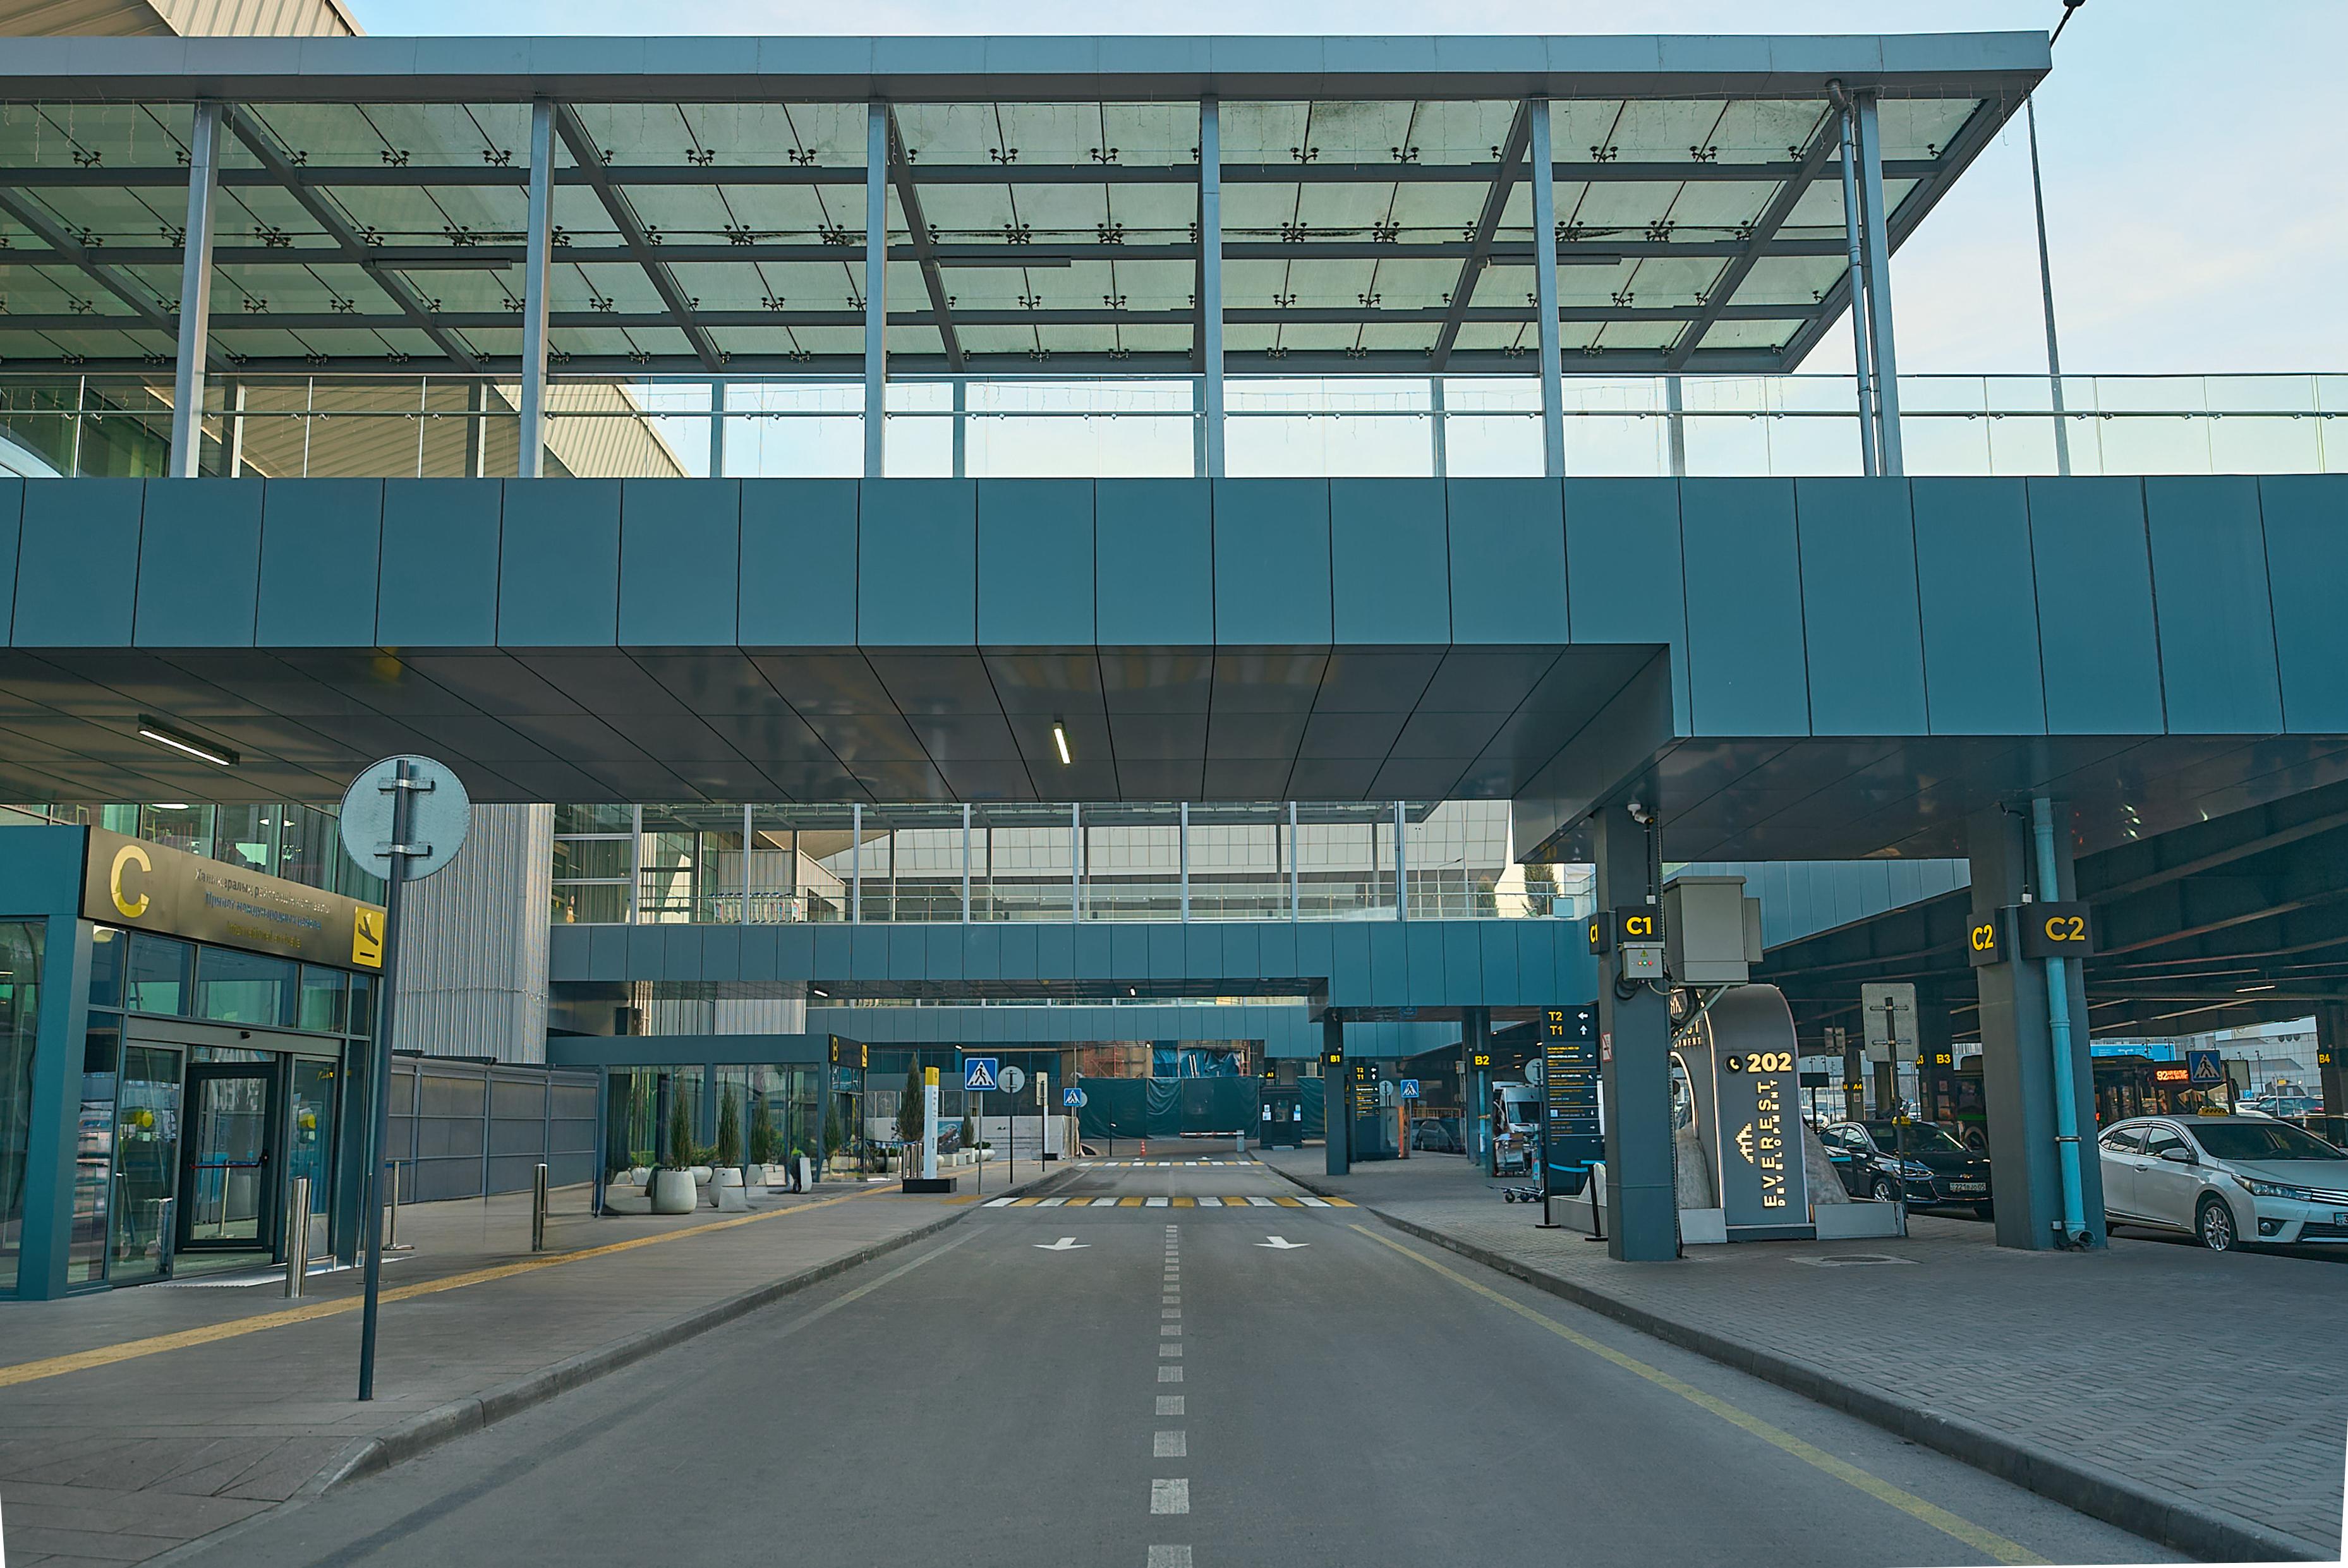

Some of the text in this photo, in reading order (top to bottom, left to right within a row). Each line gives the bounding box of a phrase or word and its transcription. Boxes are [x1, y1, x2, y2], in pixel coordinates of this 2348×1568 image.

[111, 845, 152, 919] C
[1590, 923, 1599, 943] C1
[1626, 917, 1652, 935] C1
[2045, 916, 2086, 941] C2
[1972, 924, 1994, 951] C2
[1548, 1011, 1563, 1022] T2
[1549, 1025, 1563, 1035] T1
[833, 1036, 839, 1061] B
[1330, 1054, 1340, 1063] B1
[2318, 1053, 2331, 1064] B4
[1475, 1055, 1490, 1066] B2
[1746, 1051, 1793, 1073] 202
[1935, 1054, 1951, 1064] B3
[1757, 1081, 1778, 1207] EVEREST
[1770, 1079, 1786, 1207] DEVELOPMENT
